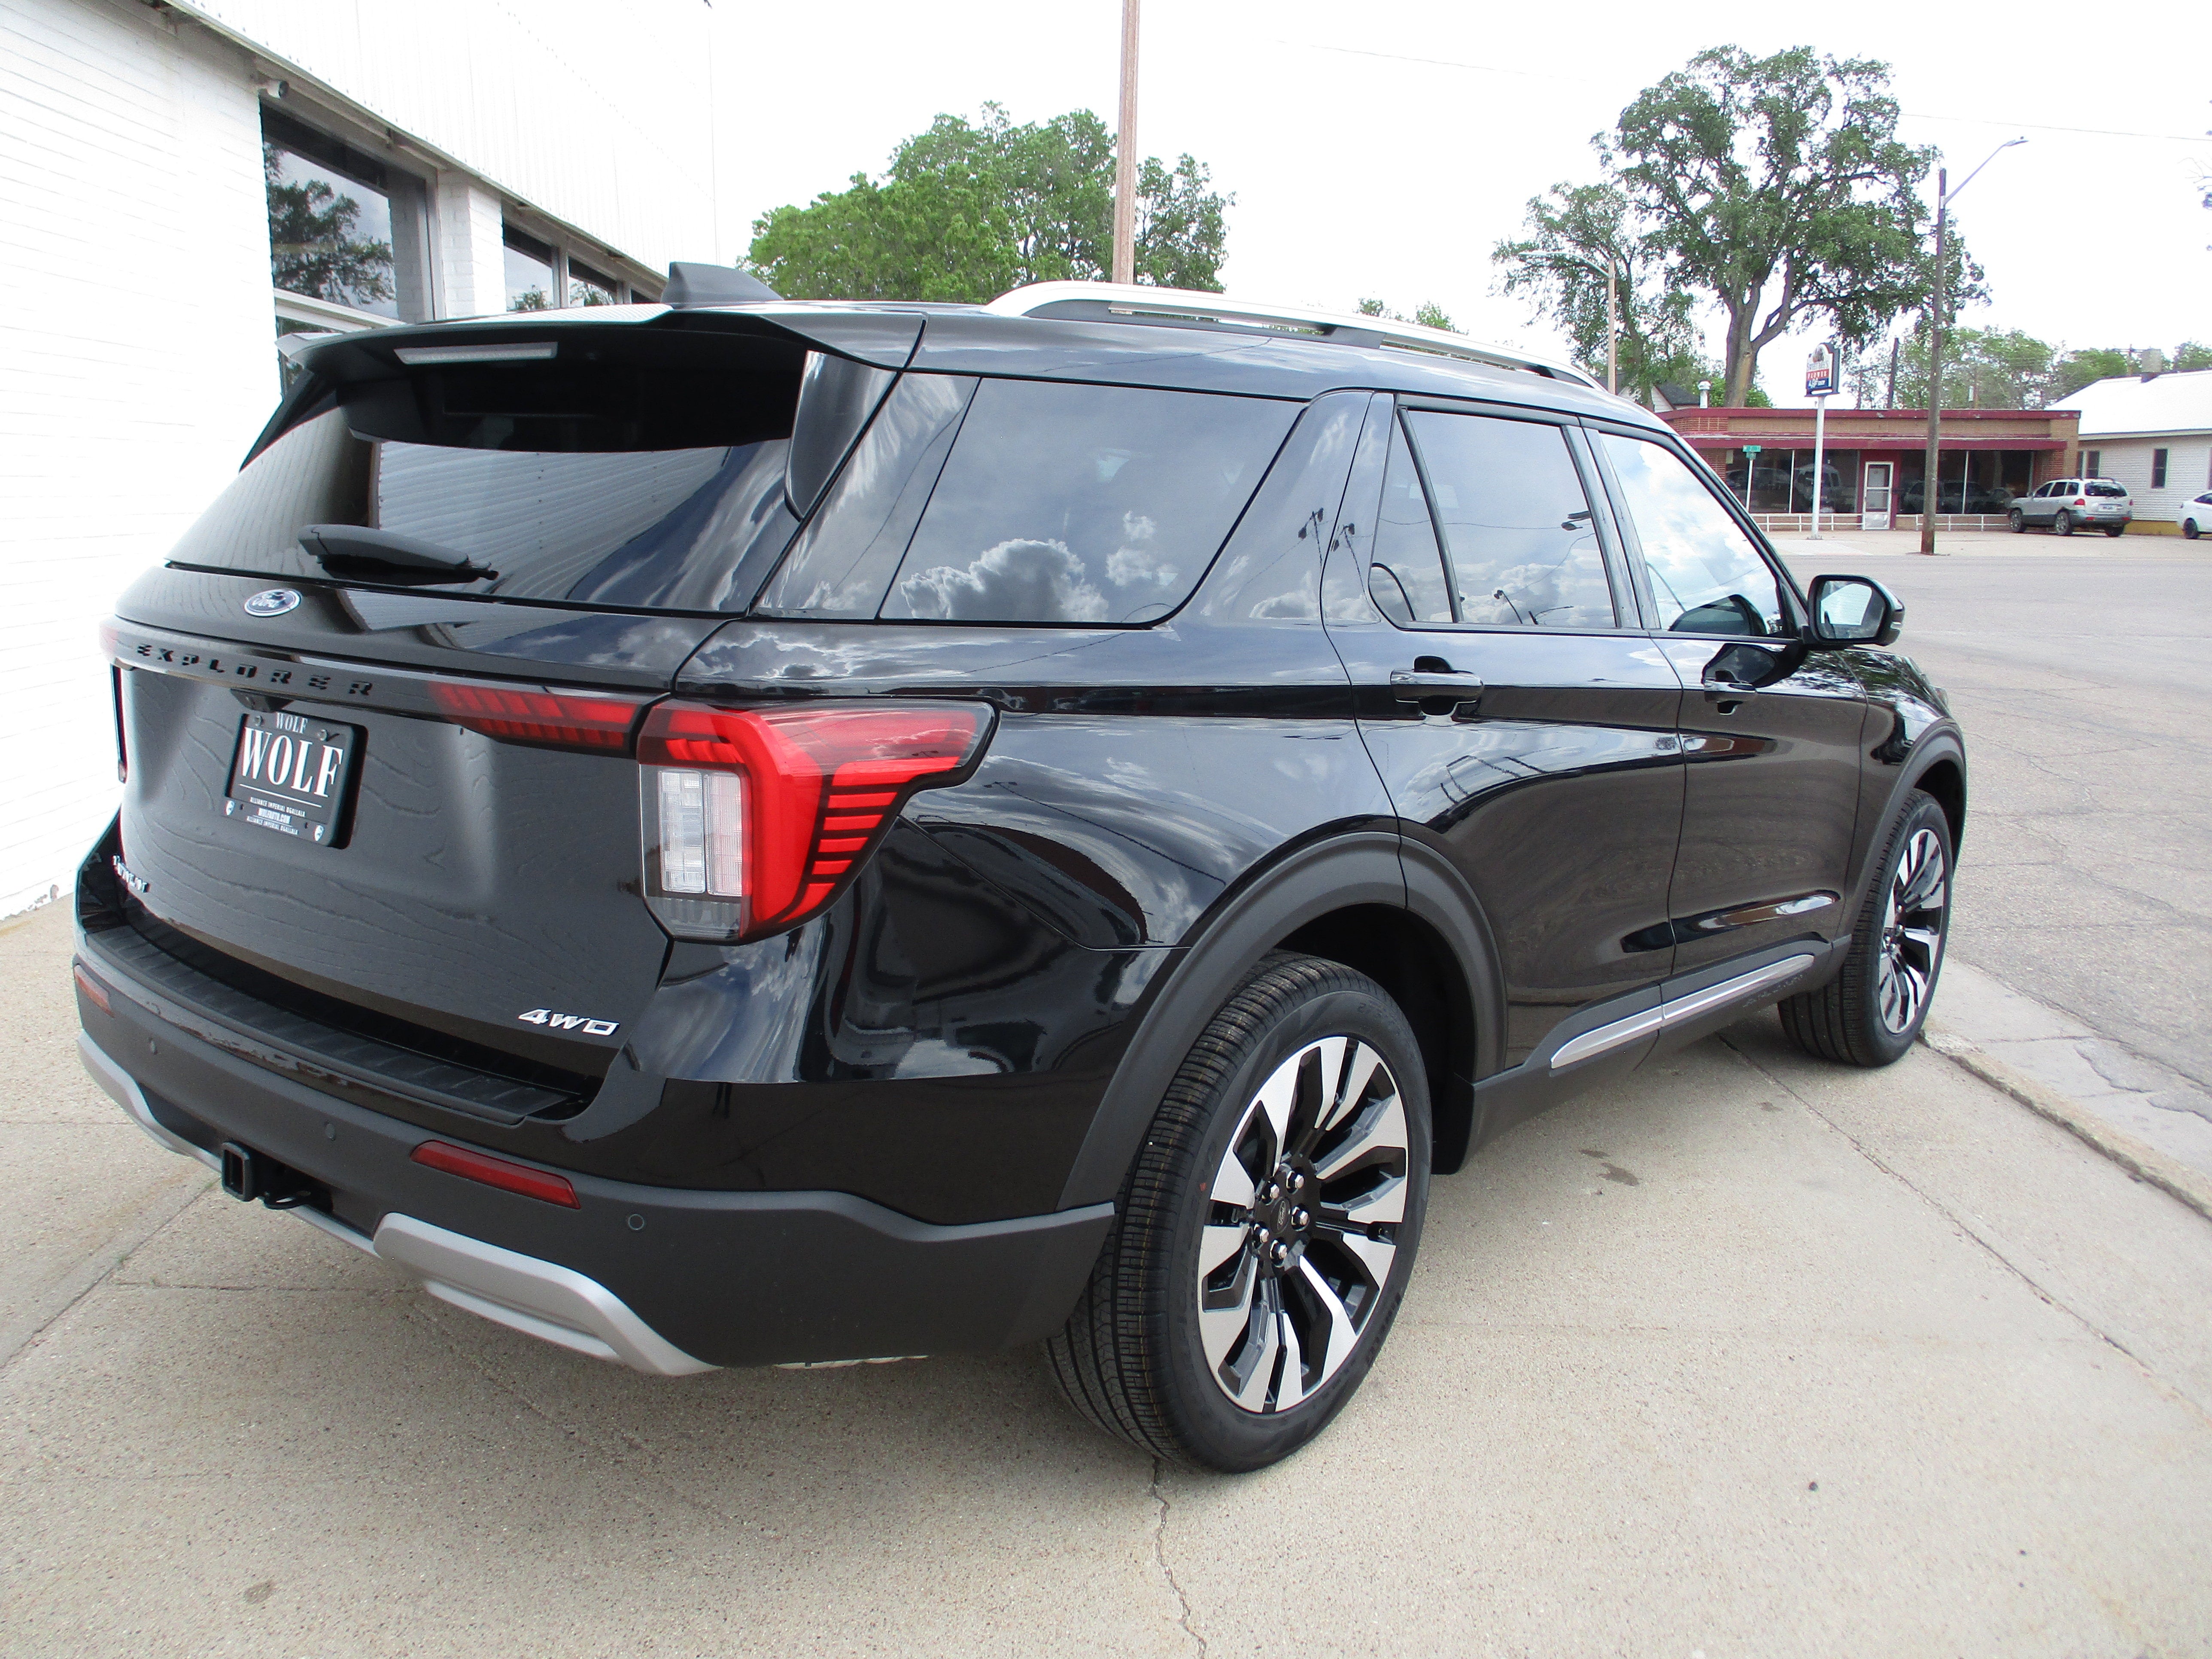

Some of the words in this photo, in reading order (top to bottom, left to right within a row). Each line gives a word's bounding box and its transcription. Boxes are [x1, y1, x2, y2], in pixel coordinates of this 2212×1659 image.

[252, 592, 286, 608] Ford
[137, 644, 373, 696] EXPLORER
[276, 712, 308, 734] WOLF
[241, 727, 343, 797] WOLF
[518, 1009, 620, 1036] 4WD
